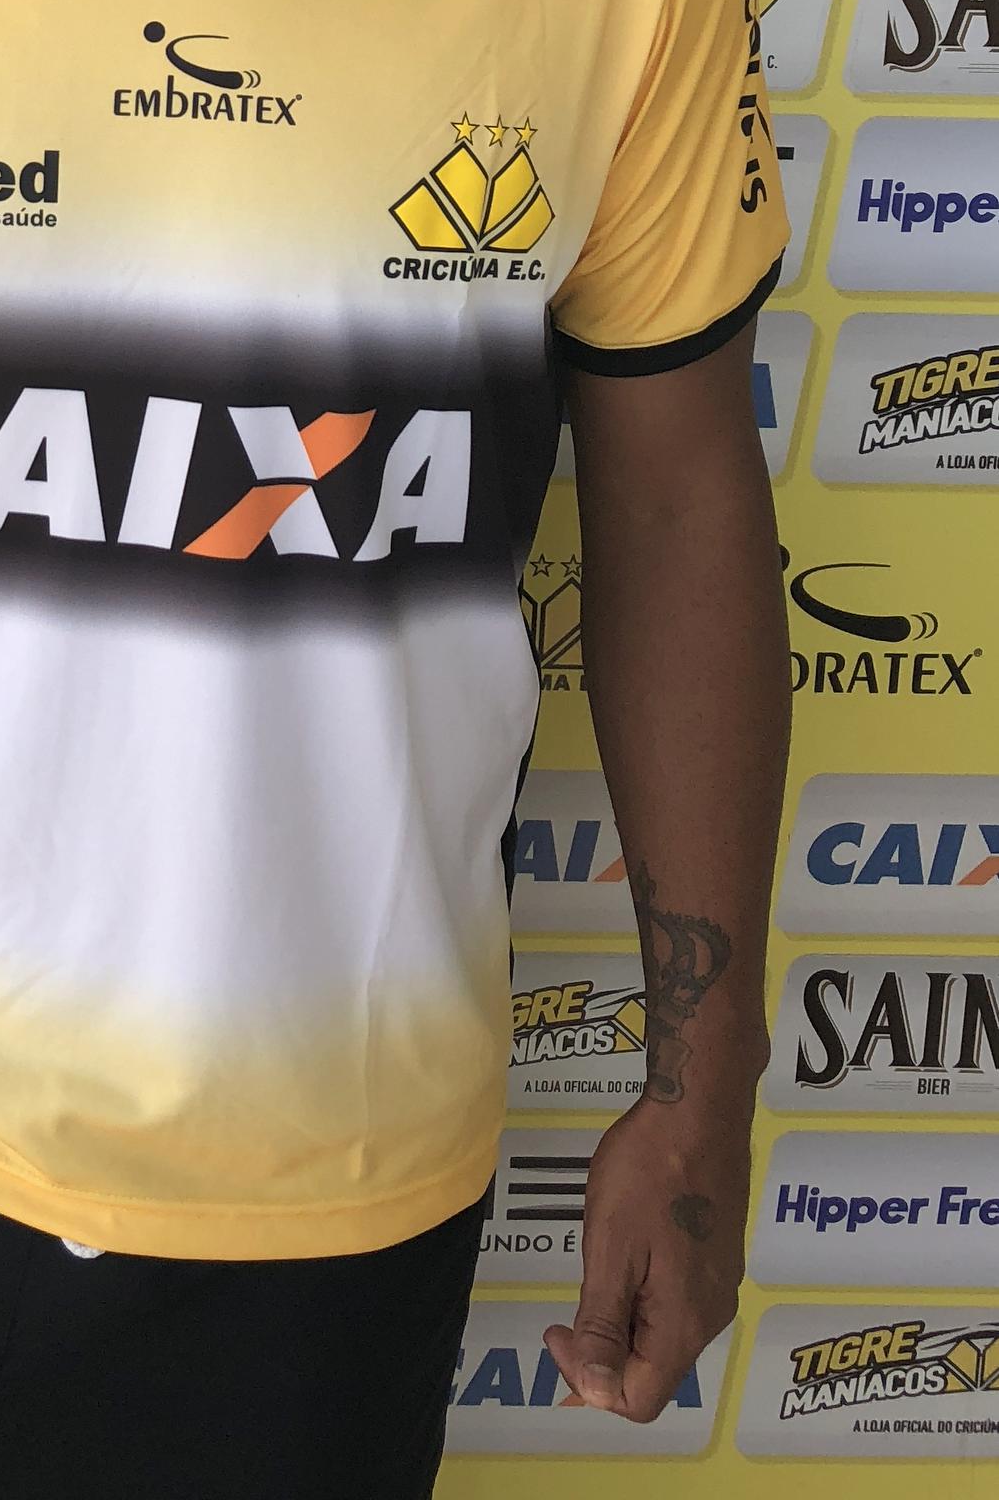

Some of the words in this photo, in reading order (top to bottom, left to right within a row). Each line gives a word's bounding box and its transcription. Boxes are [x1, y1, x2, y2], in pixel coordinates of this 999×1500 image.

[858, 179, 999, 232] Hippe
[383, 256, 498, 282] CRICIÚMA
[859, 397, 999, 454] MANÍAC
[947, 456, 975, 469] LOJA
[791, 651, 973, 694] RATEX
[807, 822, 999, 885] CAI
[511, 981, 594, 1032] GRE
[795, 969, 999, 1088] SAIN
[509, 1024, 616, 1067] NÍACOS
[535, 1081, 561, 1092] LOJA
[565, 1081, 603, 1092] OFICIAL
[608, 1082, 621, 1093] DO
[918, 1079, 950, 1095] BIER
[775, 1184, 930, 1232] Hipper
[936, 1187, 999, 1225] Fre
[480, 1235, 553, 1252] UNDO
[564, 1230, 575, 1252] É
[790, 1320, 925, 1384] TIGRE
[780, 1363, 949, 1419] MANÍACOS
[864, 1420, 890, 1432] LOJA
[956, 1419, 999, 1434] CRICIÚM
